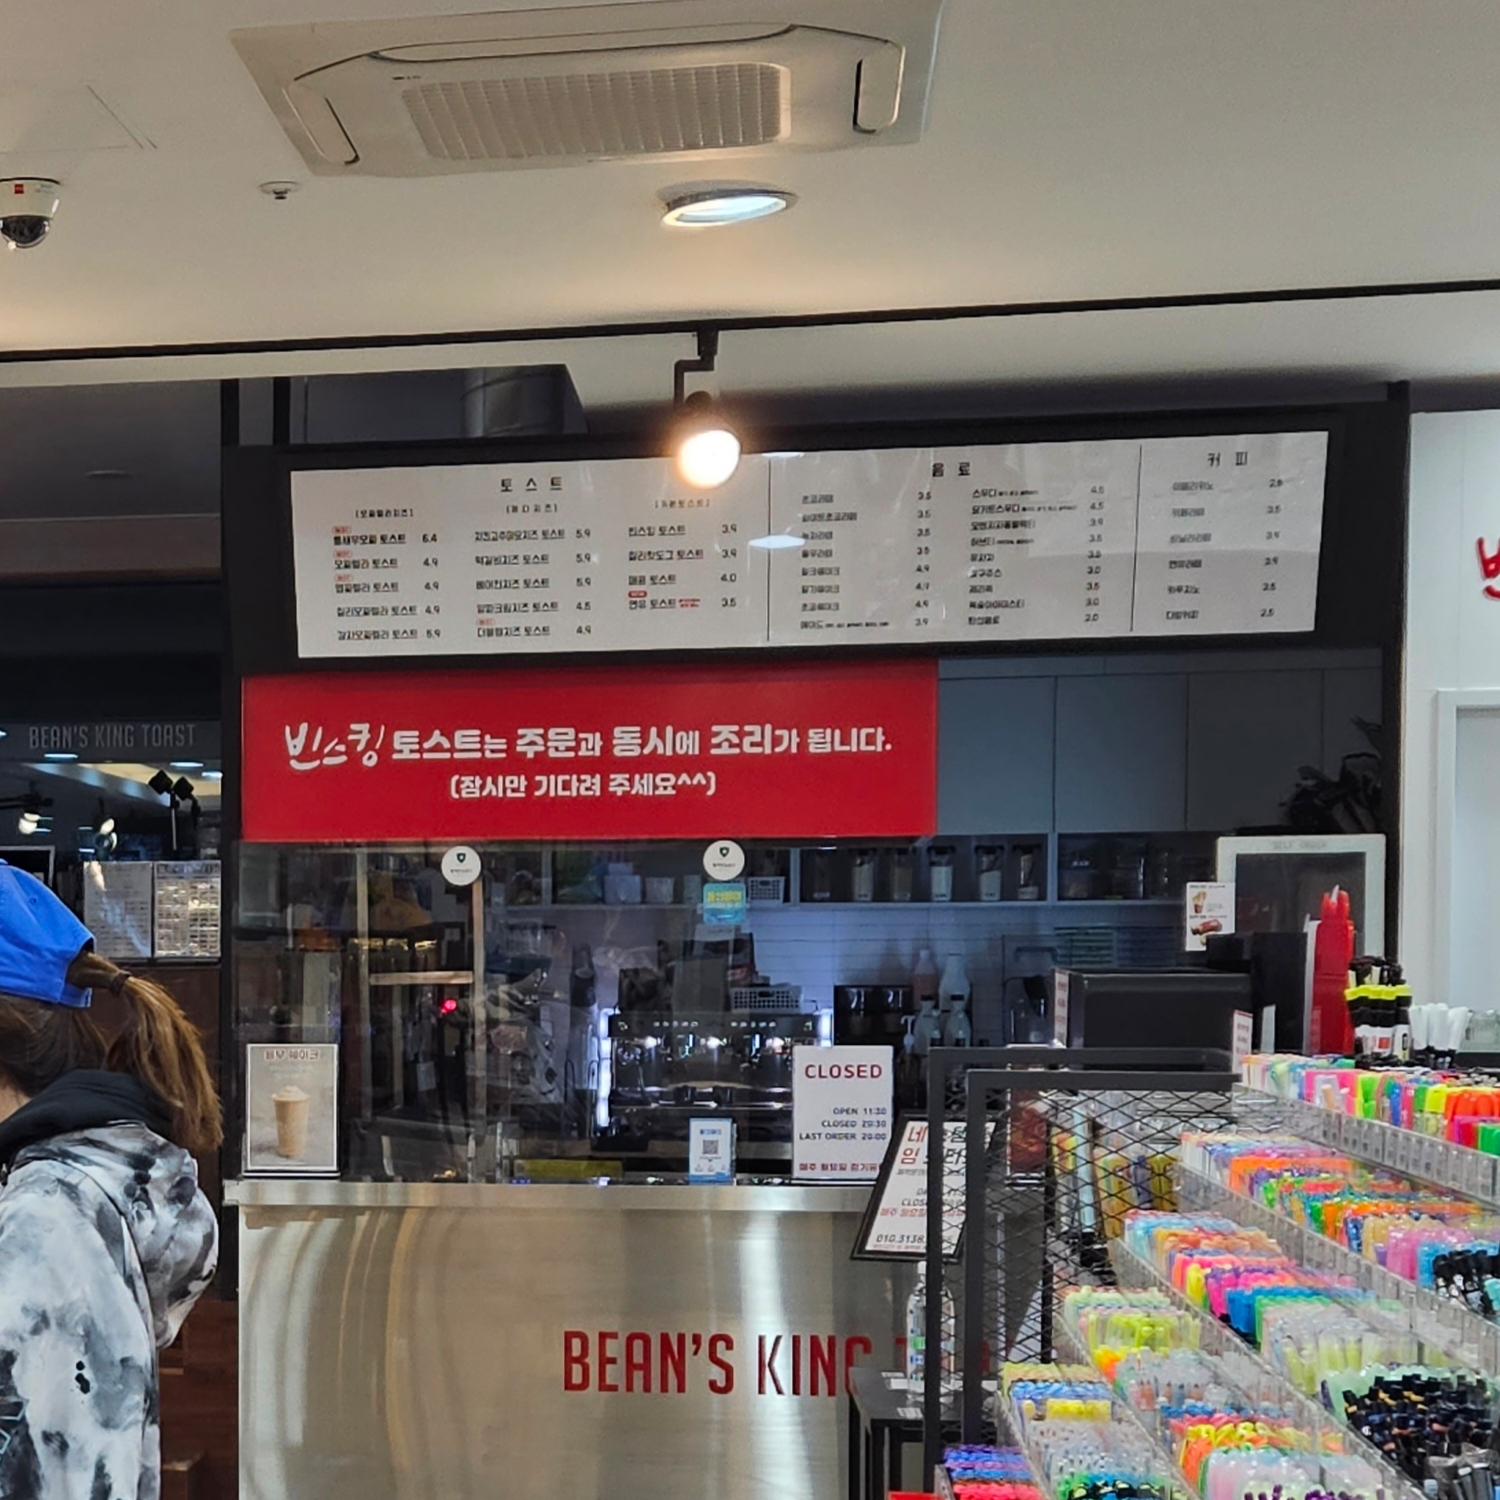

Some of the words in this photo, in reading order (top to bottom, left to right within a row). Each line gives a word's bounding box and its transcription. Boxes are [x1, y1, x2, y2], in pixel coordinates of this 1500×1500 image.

[576, 529, 591, 538] 5.9
[658, 525, 686, 535] 토스트
[523, 555, 549, 565] 토스트
[577, 554, 591, 563] 5.9
[677, 549, 703, 560] 토스트
[372, 559, 398, 568] 토스트
[423, 558, 438, 567] 4.9
[524, 578, 550, 588] 토스트
[577, 578, 591, 587] 5.9
[650, 574, 676, 584] 토스트
[424, 582, 439, 590] 4.9
[532, 602, 559, 612] 토스트
[650, 598, 676, 609] 토스트
[391, 605, 418, 615] 토스트
[425, 606, 440, 614] 4.9
[392, 630, 418, 639] 토스트
[524, 626, 550, 636] 토스트
[29, 726, 88, 748] BEAN'S
[95, 724, 134, 748] KING
[141, 724, 196, 747] TOAST
[391, 729, 508, 760] 토스트는
[515, 727, 603, 759] 주문과
[612, 725, 700, 757] 동시에
[709, 724, 800, 755] 조리가
[807, 726, 893, 753] 됩니다.
[449, 774, 528, 798] (잠시만
[533, 774, 601, 797] 기다려
[608, 772, 716, 797] 주세요^^)
[804, 1064, 883, 1079] CLOSED
[832, 1107, 858, 1115] OPEN
[821, 1120, 857, 1128] CLOSED
[799, 1132, 822, 1140] LAST
[825, 1132, 857, 1140] ORDER
[564, 1330, 734, 1394] BEAN'S
